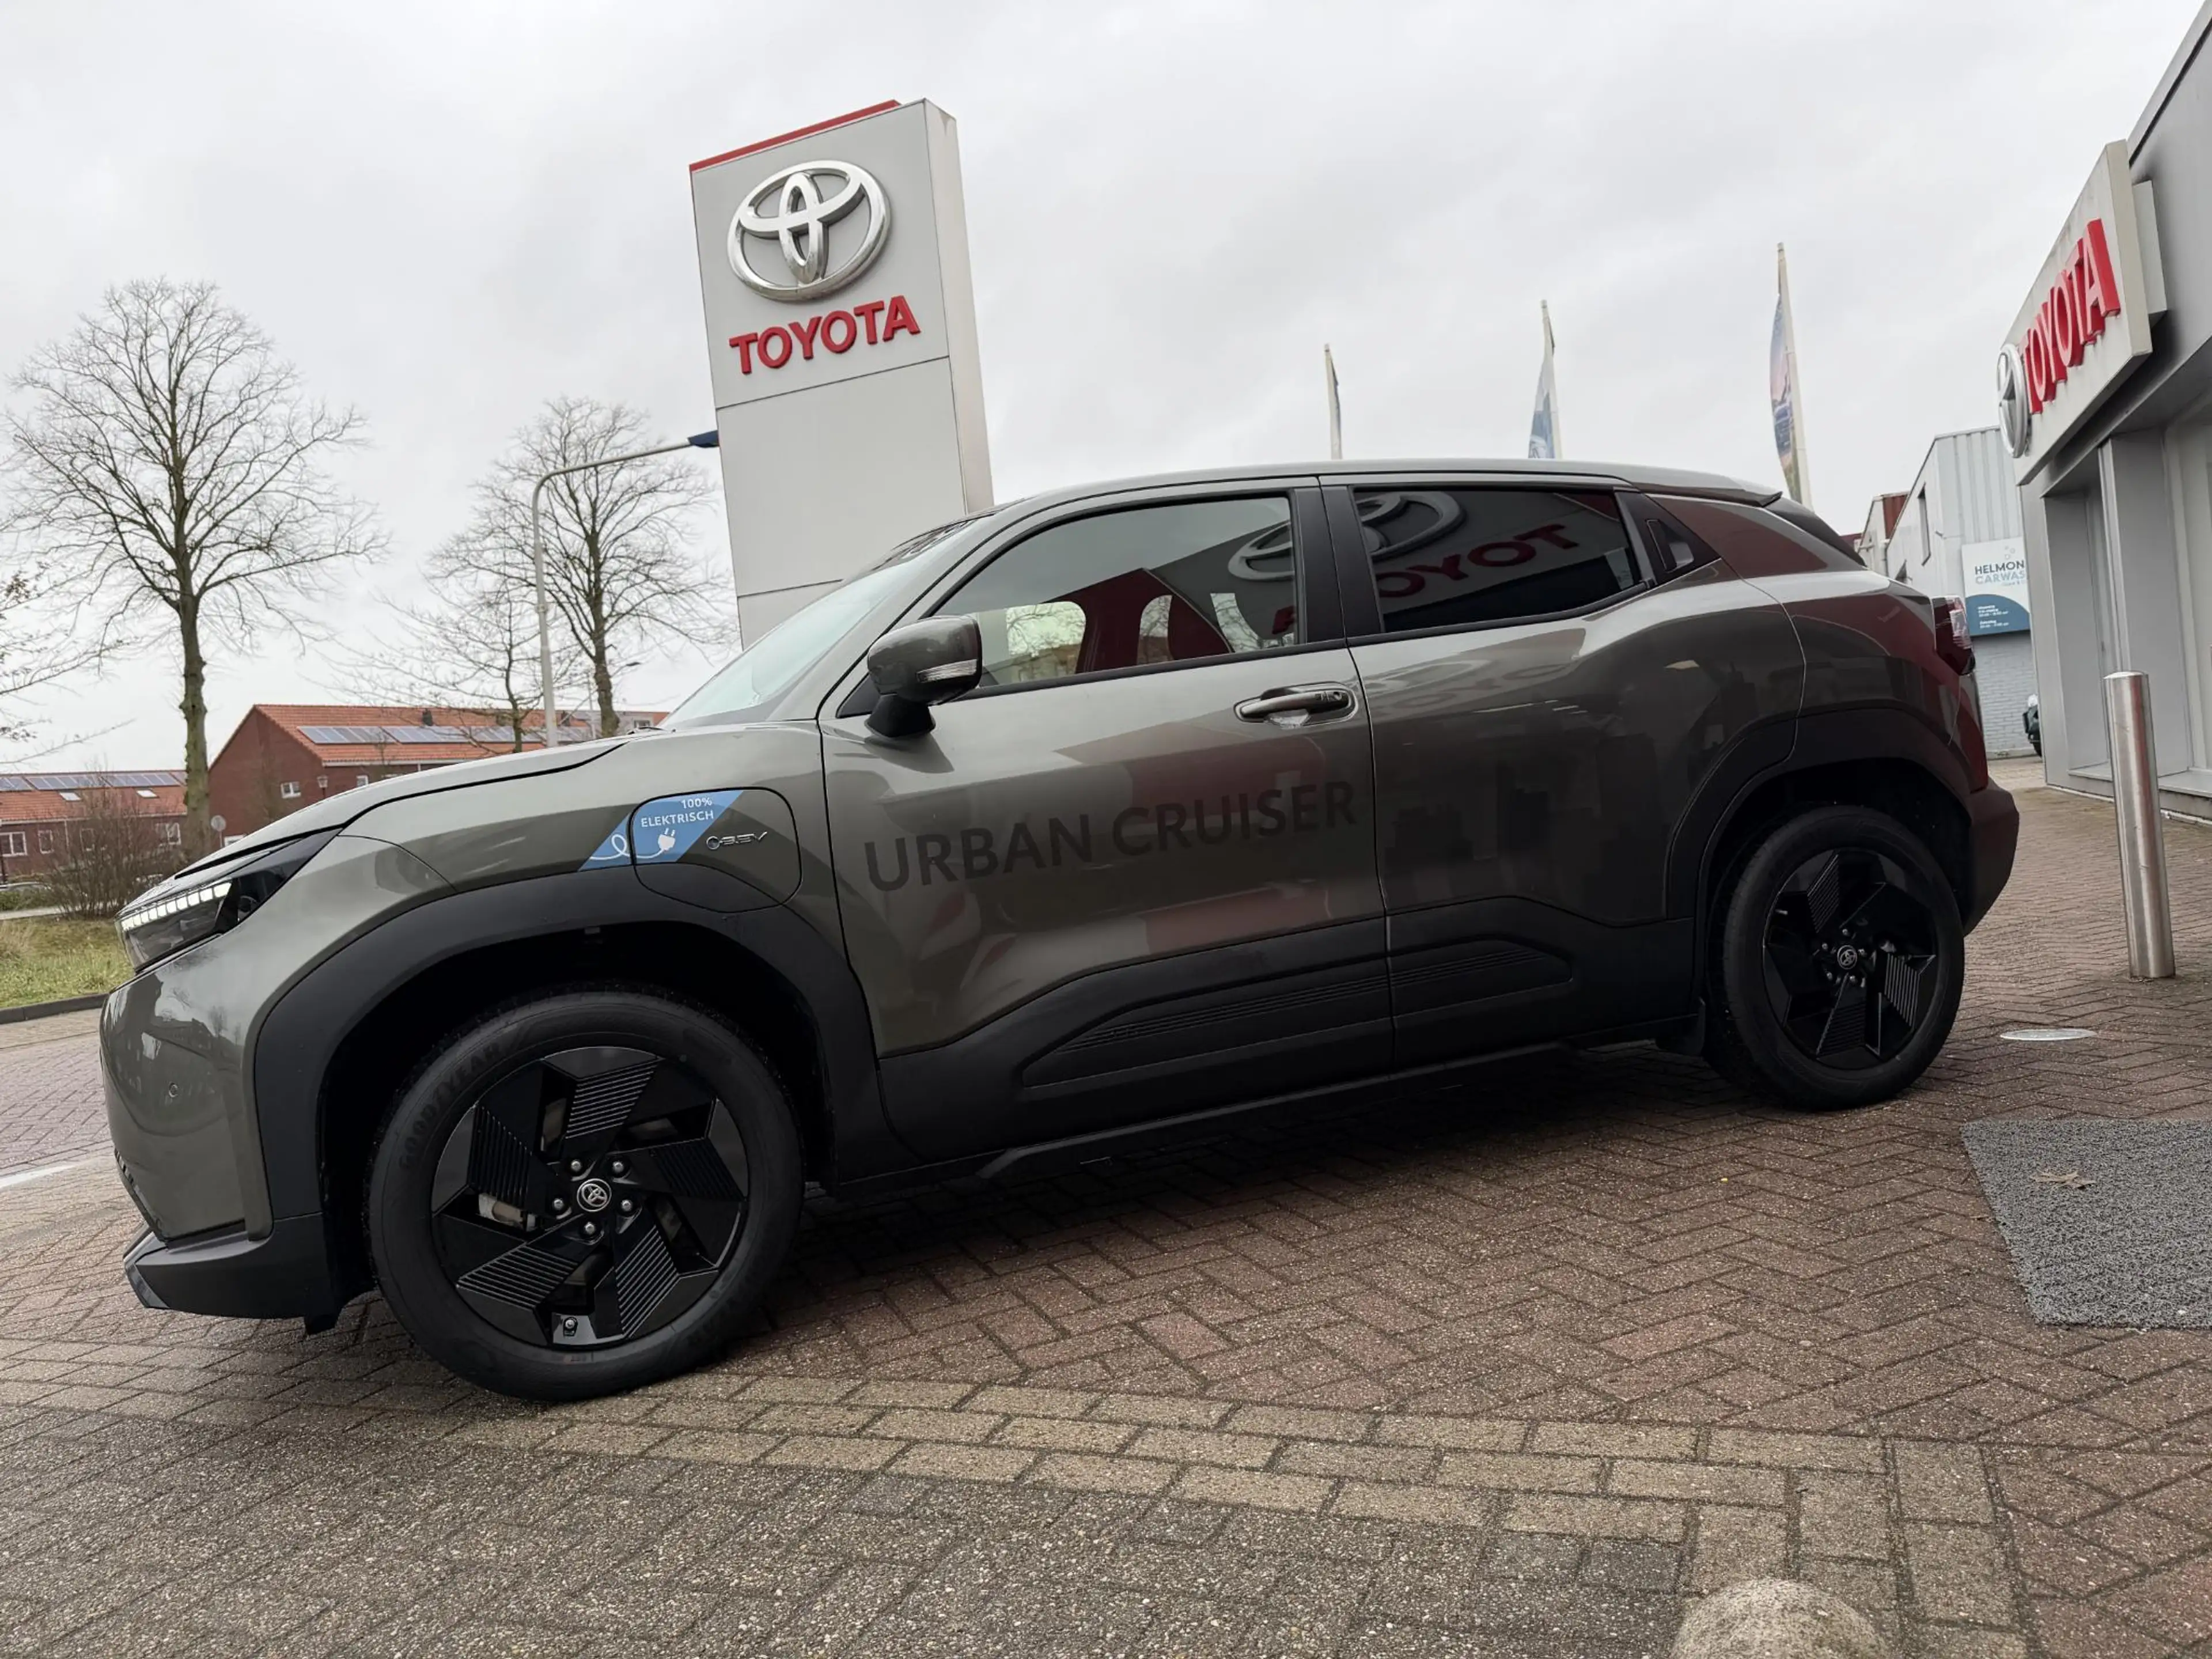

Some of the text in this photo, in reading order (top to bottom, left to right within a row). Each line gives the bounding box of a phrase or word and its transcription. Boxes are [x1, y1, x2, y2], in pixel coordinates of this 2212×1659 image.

[729, 295, 921, 374] TOYOTA
[2019, 217, 2121, 415] TOYOTA
[641, 809, 714, 827] ELEKTRISCH
[681, 797, 713, 809] 100%
[865, 781, 1357, 892] URBAN CRUISER
